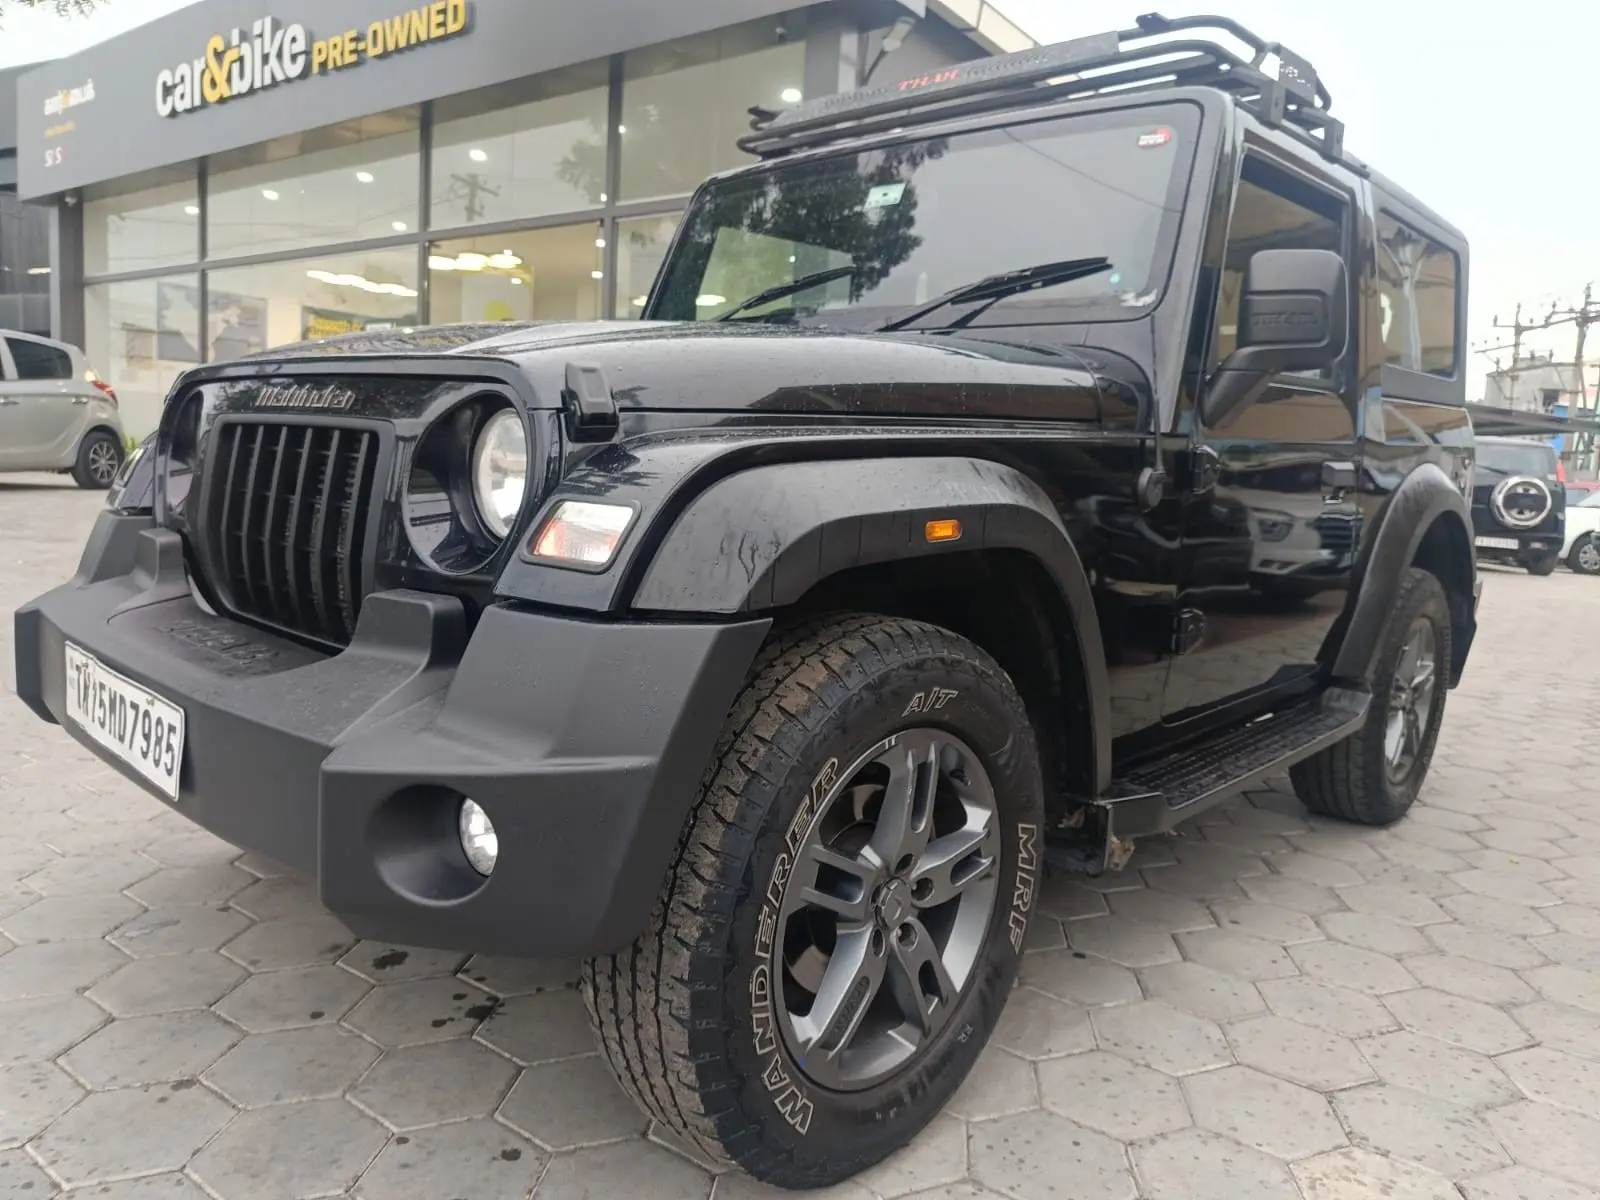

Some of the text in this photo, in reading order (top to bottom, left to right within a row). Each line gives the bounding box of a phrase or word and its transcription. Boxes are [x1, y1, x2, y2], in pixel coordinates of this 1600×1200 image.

[155, 15, 306, 117] car&bike
[311, 0, 465, 74] PRE-OWNED
[901, 686, 959, 718] A/T
[751, 756, 839, 1135] WANDERER
[1008, 823, 1037, 955] MRF
